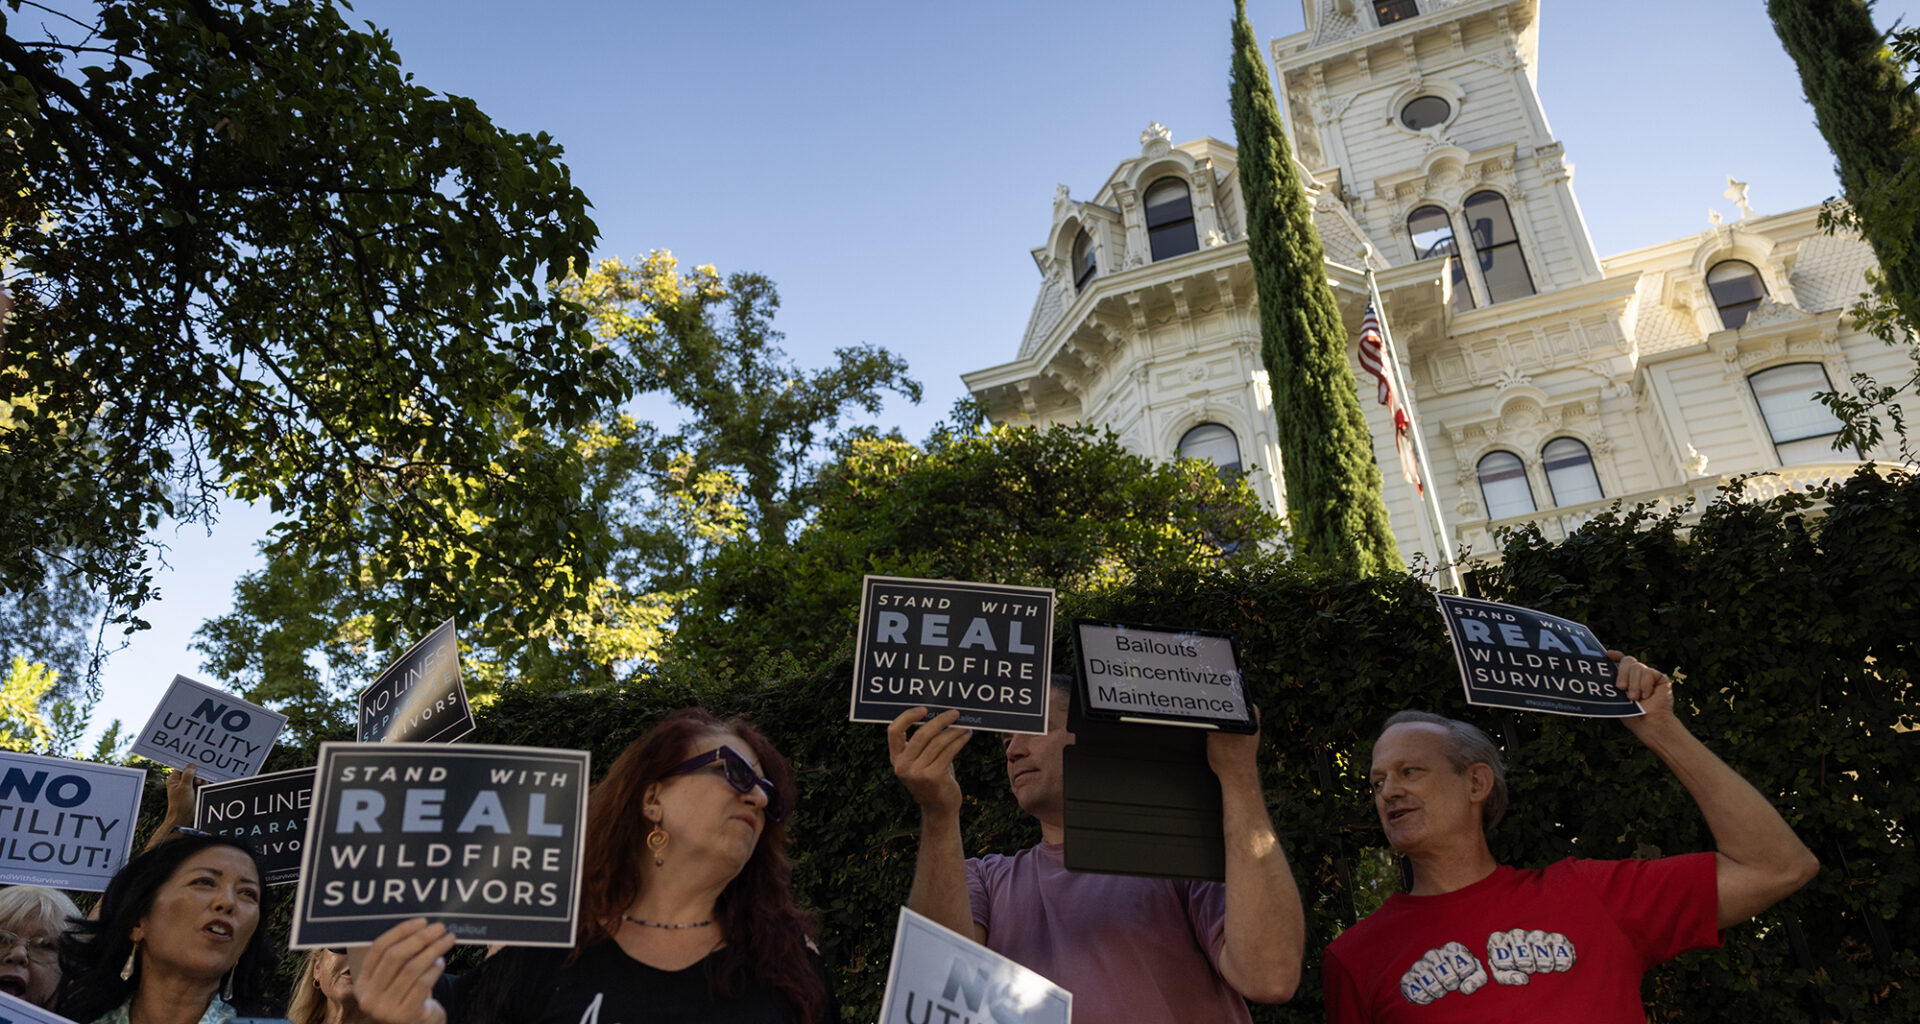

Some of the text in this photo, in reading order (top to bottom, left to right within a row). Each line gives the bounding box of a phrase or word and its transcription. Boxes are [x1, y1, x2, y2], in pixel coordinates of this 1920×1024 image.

[878, 594, 1038, 617] STAND WITH
[876, 610, 1035, 655] REAL
[1454, 606, 1585, 637] STAND WITH
[1115, 635, 1197, 658] Bailouts
[1460, 618, 1606, 657] REAL
[873, 651, 1034, 680] WILDFIRE
[1090, 658, 1232, 687] Disincentivize
[1469, 647, 1612, 677] WILDFIRE
[365, 645, 449, 725] NO LINES
[869, 676, 1033, 705] SURVIVORS
[1475, 667, 1618, 698] SURVIVORS
[191, 697, 251, 732] NO
[1098, 686, 1234, 713] Maintenance
[163, 711, 261, 758] UTILITY
[151, 730, 250, 776] BAILOUT!
[0, 767, 91, 808] NO
[340, 766, 568, 788] STAND WITH
[208, 789, 312, 824] NO LINE
[335, 789, 564, 838] REAL
[0, 837, 111, 869] ILOUT!
[330, 843, 561, 872] WILDFIRE
[322, 878, 558, 907] SURVIVORS
[1409, 943, 1570, 997] ALTA DENA
